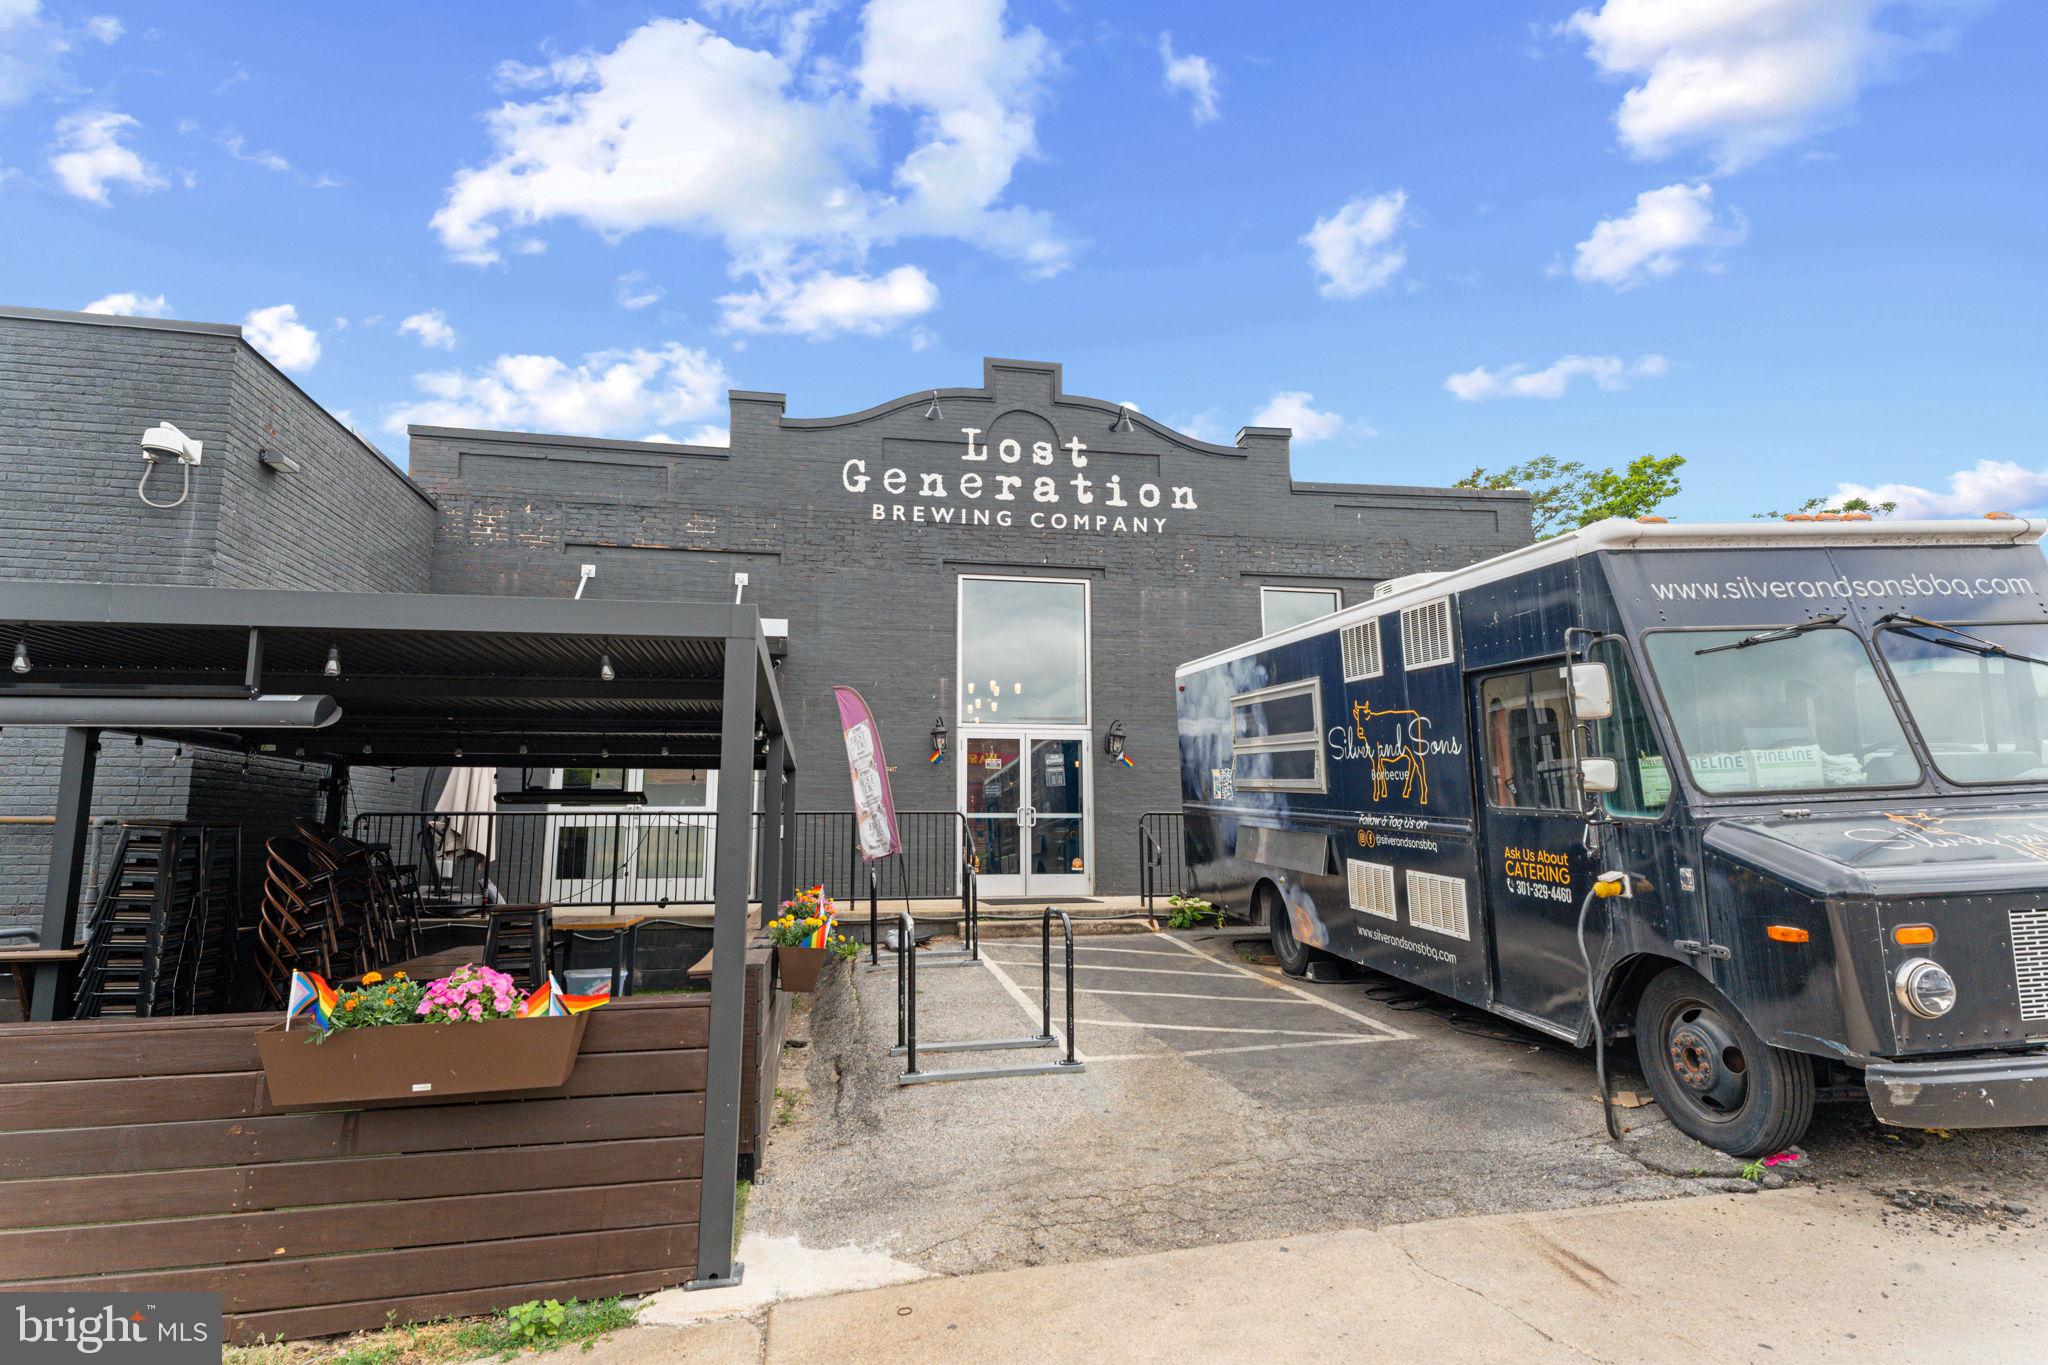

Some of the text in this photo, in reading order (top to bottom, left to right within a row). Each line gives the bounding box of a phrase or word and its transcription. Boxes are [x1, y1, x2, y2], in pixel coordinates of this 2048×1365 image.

[962, 428, 1087, 467] Lost
[843, 459, 1197, 509] Generation
[873, 504, 1168, 534] BREWING COMPANY
[1651, 573, 2034, 599] www.silverandsonsbbq.com
[1328, 717, 1463, 760] Silver and Sons
[1757, 749, 1814, 763] FINELINE
[1371, 768, 1409, 781] Barbecue
[1358, 814, 1428, 829] Follow & Tag Us on
[1376, 834, 1438, 852] @silverandsonsbbq
[1504, 846, 1569, 866] Ask Us About
[1505, 861, 1571, 885] CATERING
[1516, 880, 1572, 904] 301-329-4460
[1357, 925, 1457, 965] www.silverandsonsbbq.com
